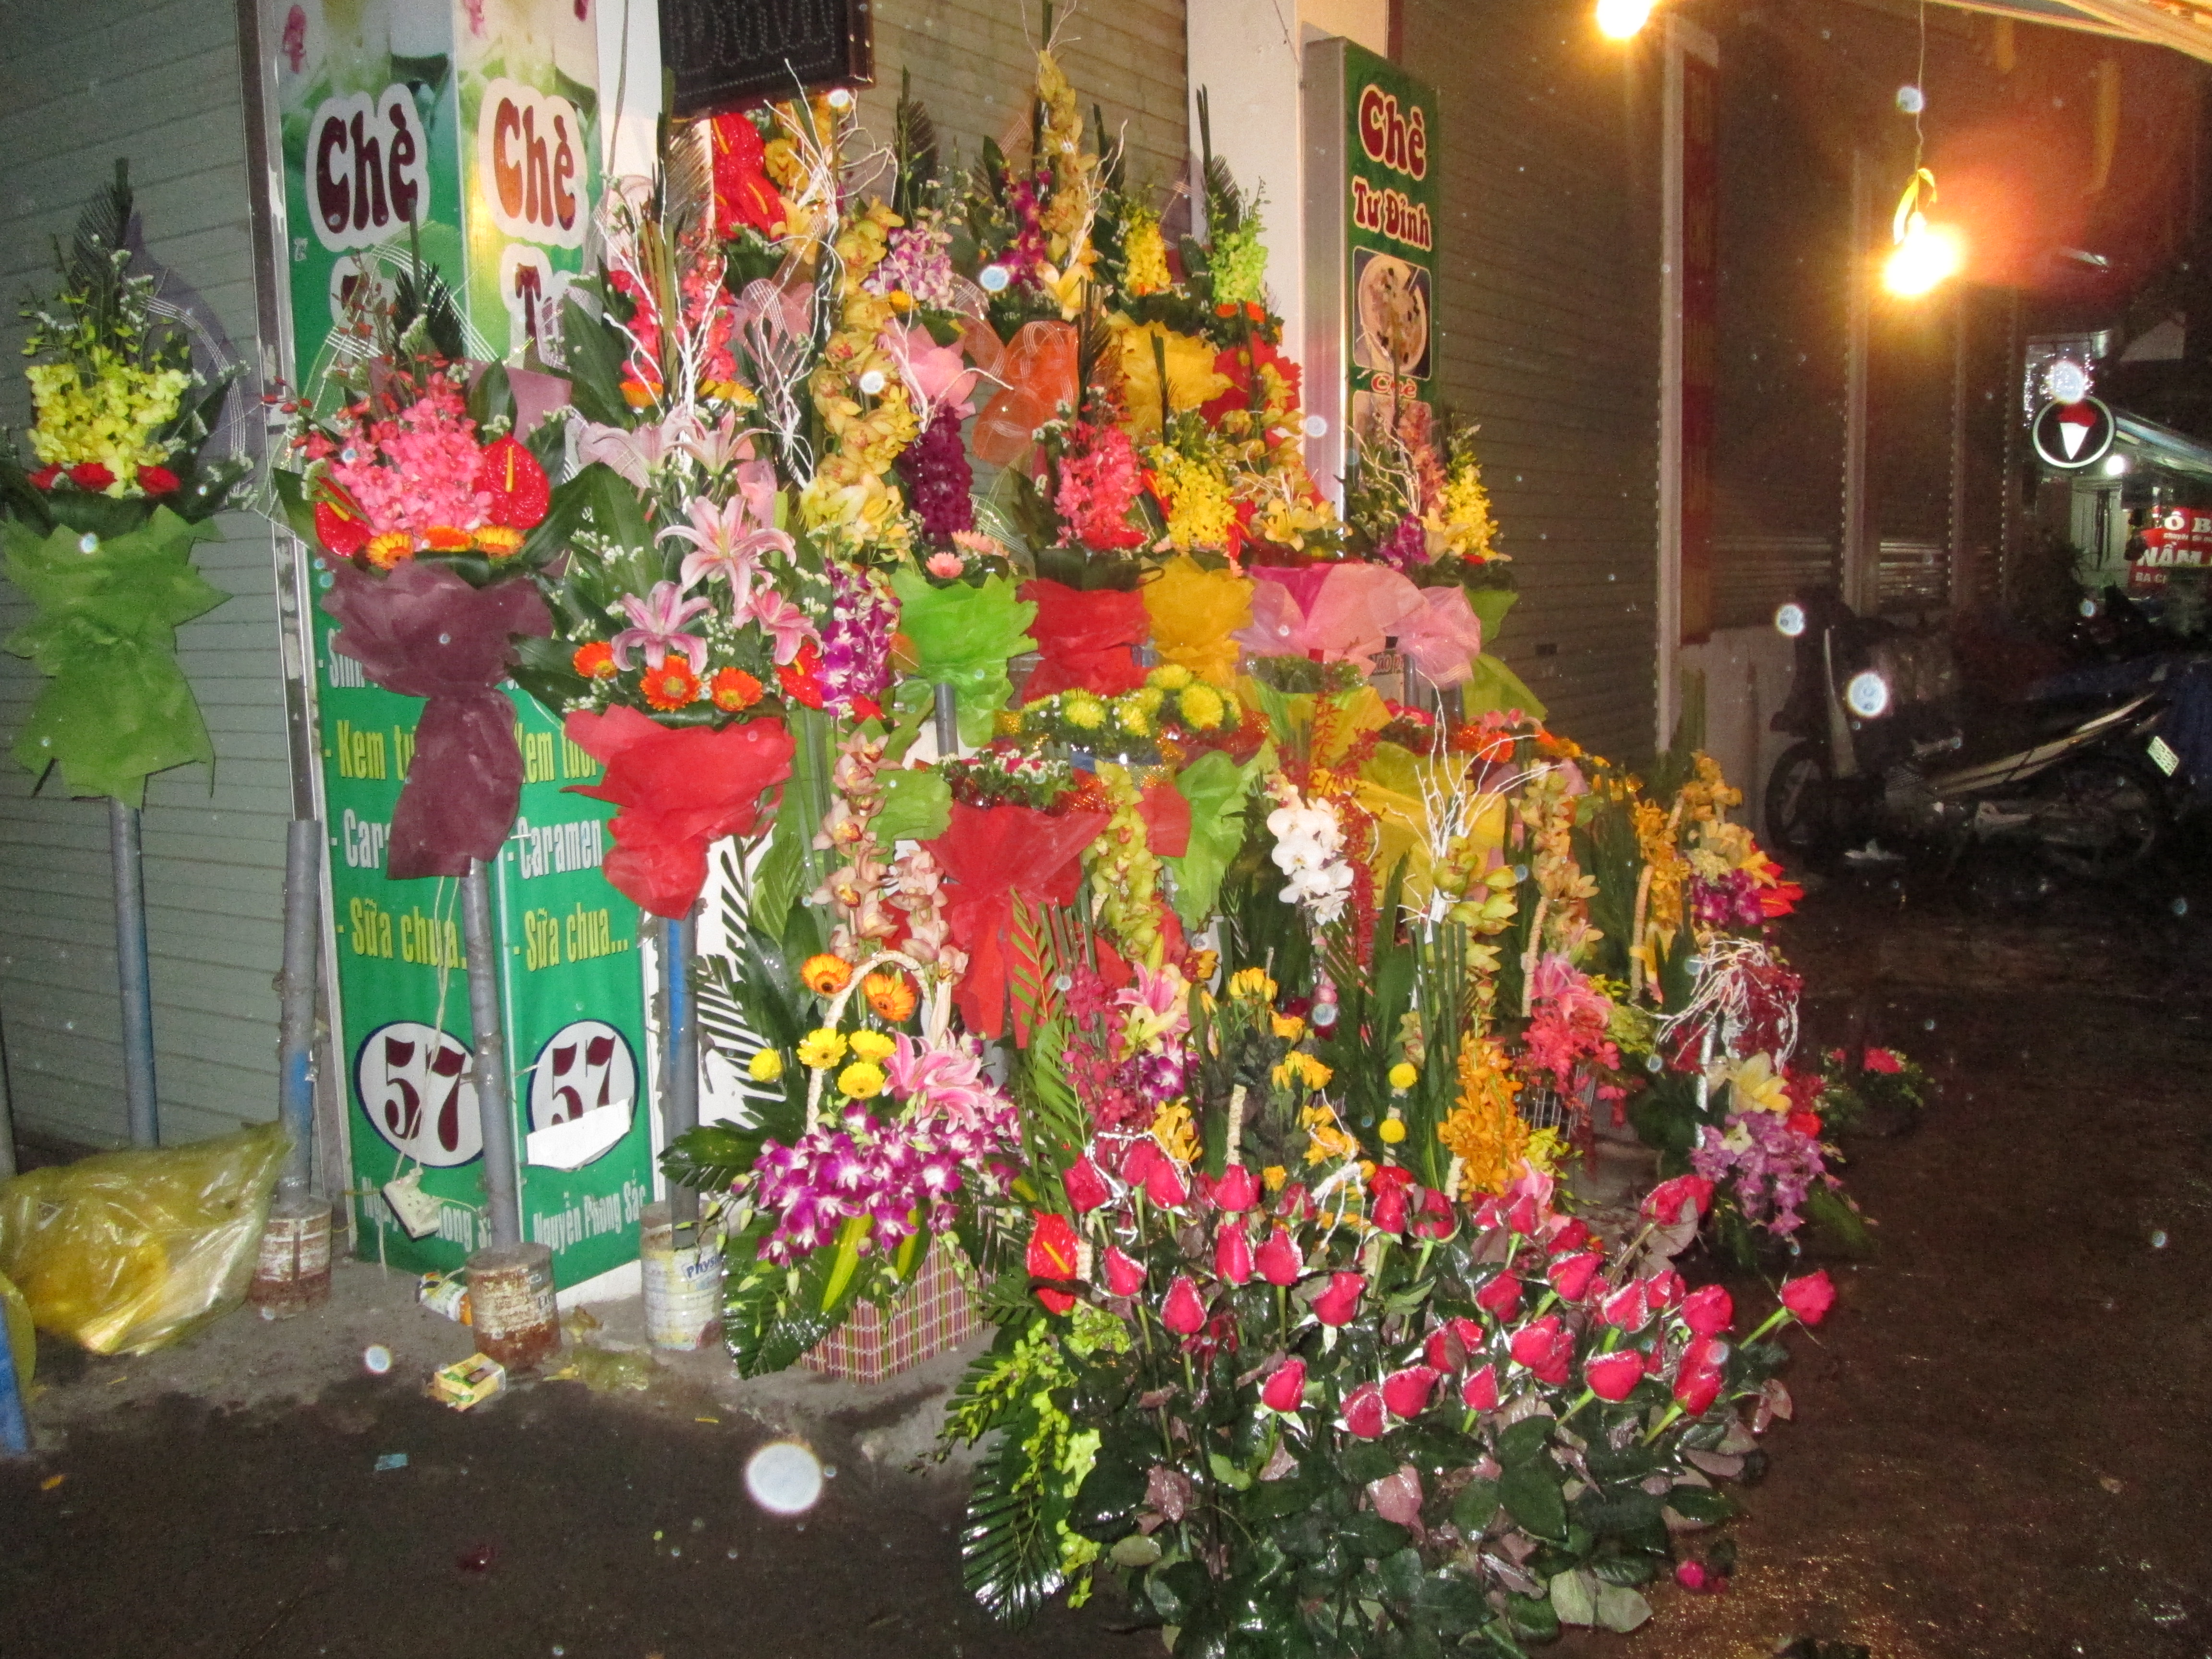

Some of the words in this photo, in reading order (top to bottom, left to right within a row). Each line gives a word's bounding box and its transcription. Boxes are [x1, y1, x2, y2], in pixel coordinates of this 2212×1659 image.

[493, 97, 575, 230] Chè
[1361, 90, 1424, 176] Chè
[316, 103, 418, 234] Chè
[1355, 181, 1381, 228] Tư
[337, 720, 386, 780] Kem
[344, 808, 391, 869] Car
[517, 817, 602, 879] Caramen
[350, 897, 393, 959] Sữa
[525, 908, 560, 972] Sữa
[385, 1036, 466, 1152] 57
[552, 1035, 616, 1127] 57
[533, 1191, 582, 1255] Nguyễn
[583, 1193, 622, 1238] Phong
